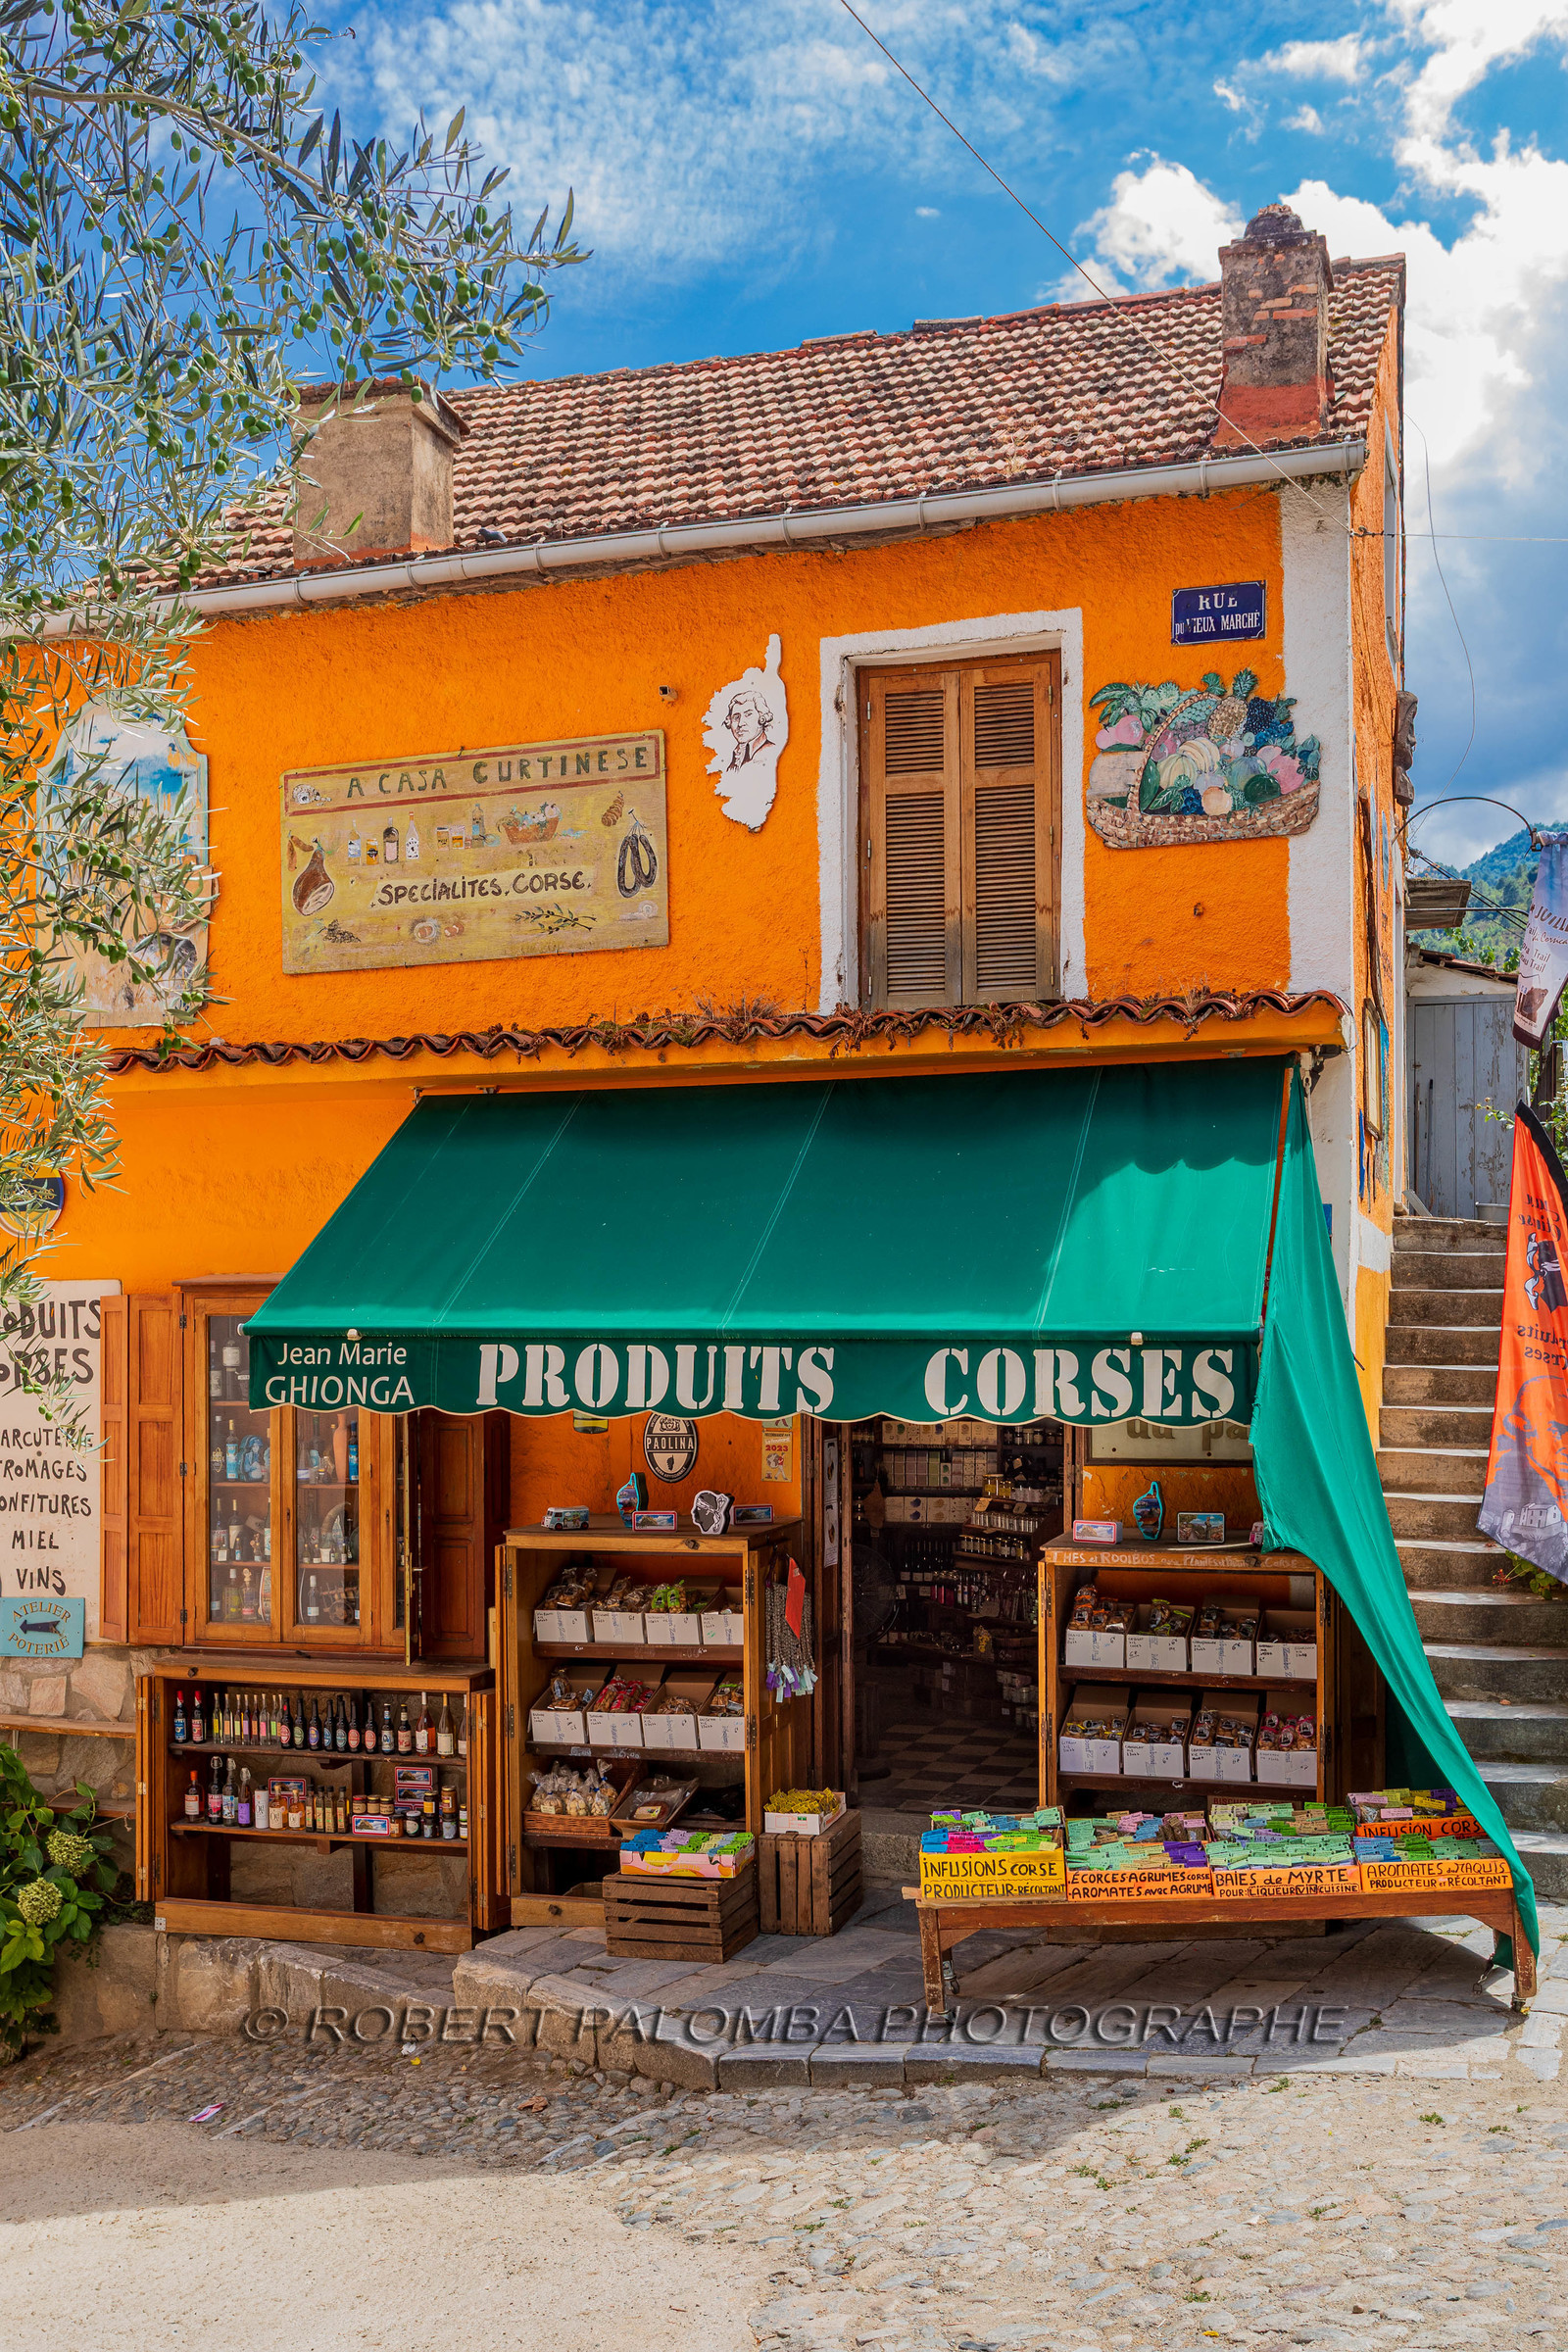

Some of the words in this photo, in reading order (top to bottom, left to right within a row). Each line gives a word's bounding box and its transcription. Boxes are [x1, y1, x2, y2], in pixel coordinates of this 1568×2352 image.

[1175, 622, 1185, 635] DU
[347, 777, 365, 798] A
[378, 768, 447, 794] CASA
[472, 747, 647, 784] CURTINESE
[277, 1343, 331, 1365] Jean
[338, 1342, 407, 1365] Marie
[265, 1376, 415, 1404] GHIONGA
[476, 1344, 835, 1413] PRODUITS
[924, 1348, 1235, 1418] CORSES
[646, 1437, 694, 1449] PAOLINA
[12, 1530, 59, 1549] MIEL
[1100, 1551, 1156, 1565] ROOIBOS
[16, 1566, 66, 1595] VINS
[12, 1601, 71, 1623] ATELIER
[8, 1632, 70, 1655] POTERIE
[923, 1856, 1006, 1878] INFUSIONS
[1010, 1863, 1057, 1876] CORSE
[1215, 1871, 1256, 1886] BAIES
[1263, 1874, 1282, 1885] de
[1288, 1868, 1348, 1885] MYRTE
[1367, 1862, 1443, 1878] AROMATES
[1297, 1885, 1317, 1894] VIN
[1319, 1884, 1358, 1893] CUISINE
[1370, 1878, 1437, 1888] PRODUCTEUR
